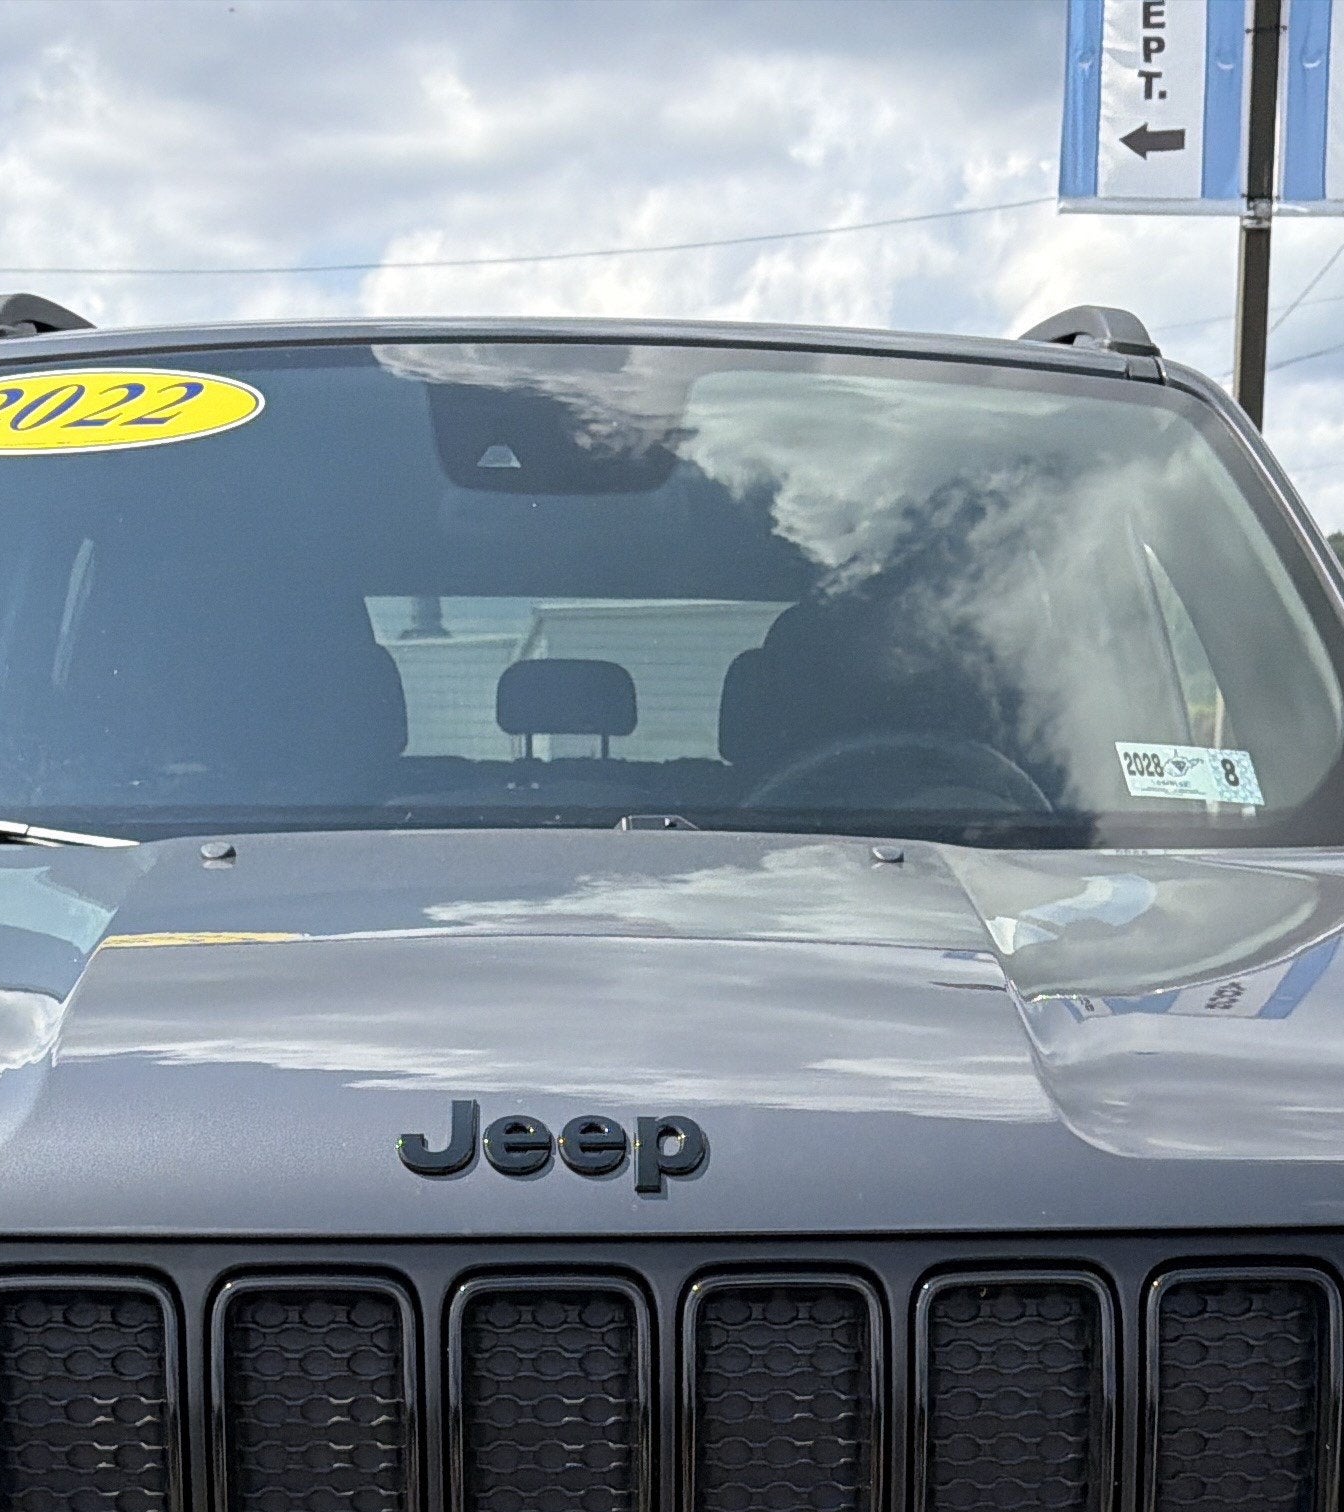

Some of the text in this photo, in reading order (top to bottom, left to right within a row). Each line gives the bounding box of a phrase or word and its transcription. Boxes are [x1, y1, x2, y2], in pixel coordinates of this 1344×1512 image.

[1123, 751, 1240, 787] 2028 8
[397, 1099, 708, 1194] Jeep
